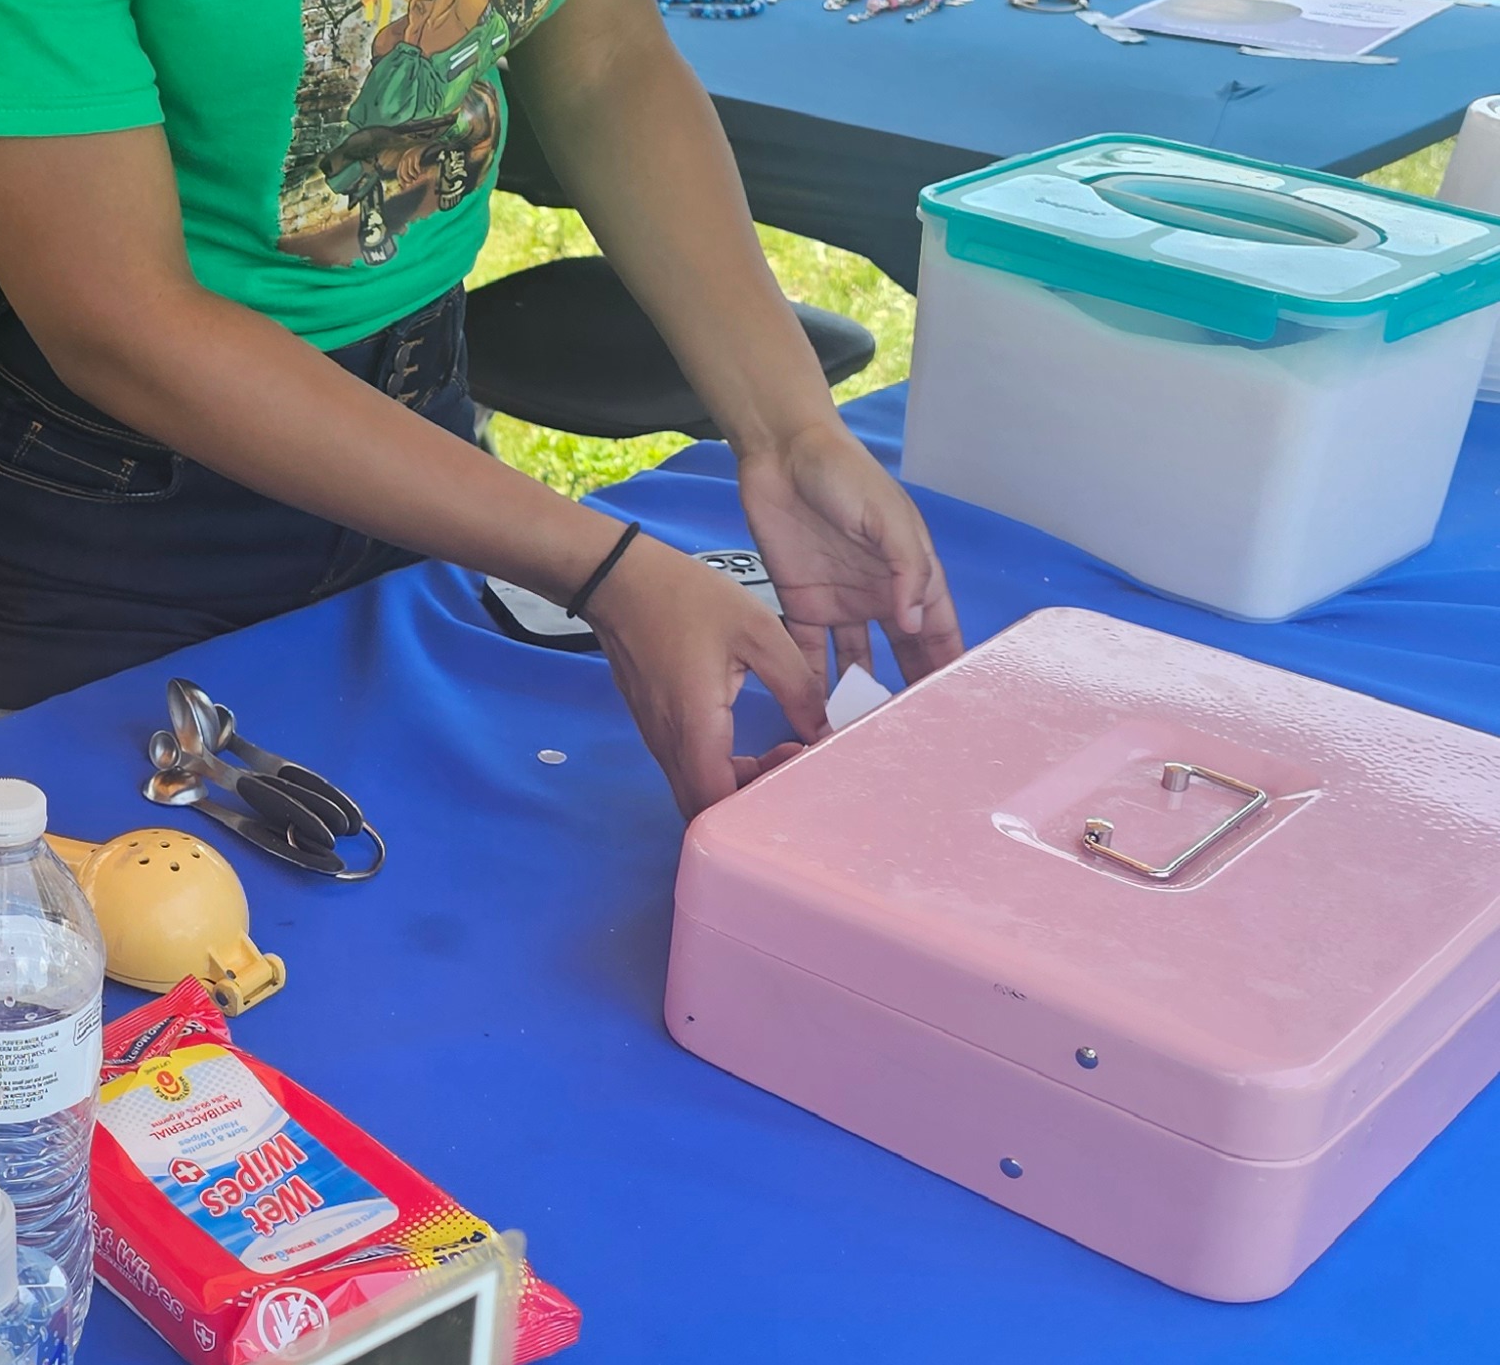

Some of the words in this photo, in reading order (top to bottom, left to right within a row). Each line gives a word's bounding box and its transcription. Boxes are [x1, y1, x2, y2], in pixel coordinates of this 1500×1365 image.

[150, 1098, 243, 1141] ANTIBACTERIAL
[200, 1131, 309, 1217] Wipes
[241, 1174, 325, 1237] Wet
[116, 1238, 186, 1323] Wipes
